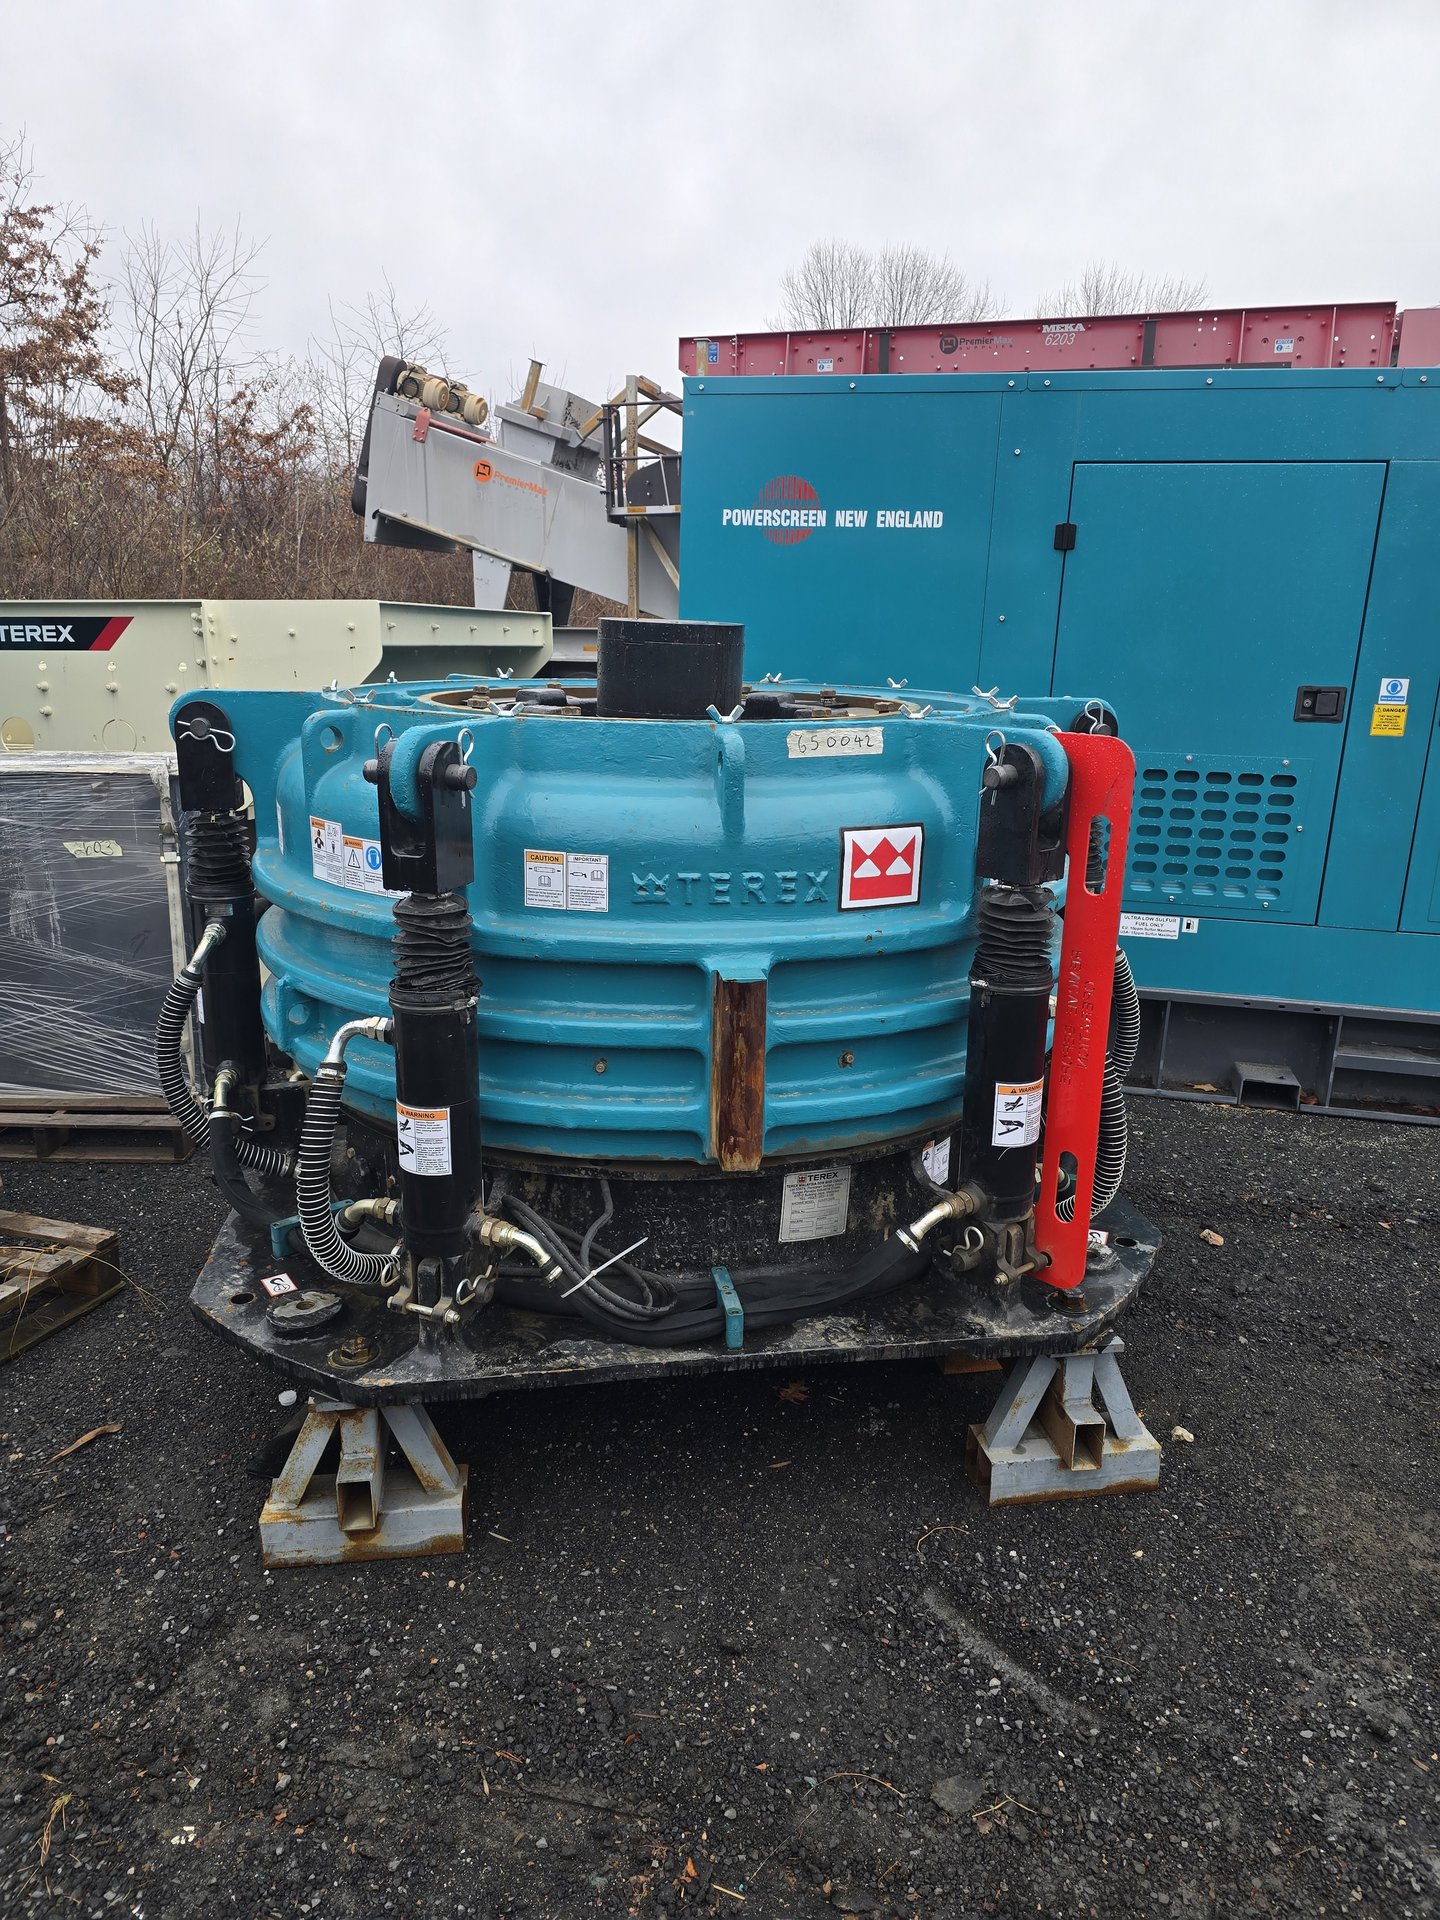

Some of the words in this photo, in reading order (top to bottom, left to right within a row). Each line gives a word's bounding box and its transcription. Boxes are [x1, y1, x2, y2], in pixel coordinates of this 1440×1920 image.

[1042, 323, 1086, 333] MEKA
[959, 336, 1013, 346] PremierMax
[1045, 333, 1076, 346] 6203
[722, 509, 827, 527] POWERSCREEN
[835, 510, 867, 528] NEW
[876, 510, 944, 528] ENGLAND
[0, 625, 75, 642] TEREX
[797, 734, 874, 754] 650042
[530, 854, 559, 863] CAUTION
[677, 871, 829, 904] TEREX
[405, 1110, 435, 1119] WARNING
[808, 1171, 839, 1182] TEREX
